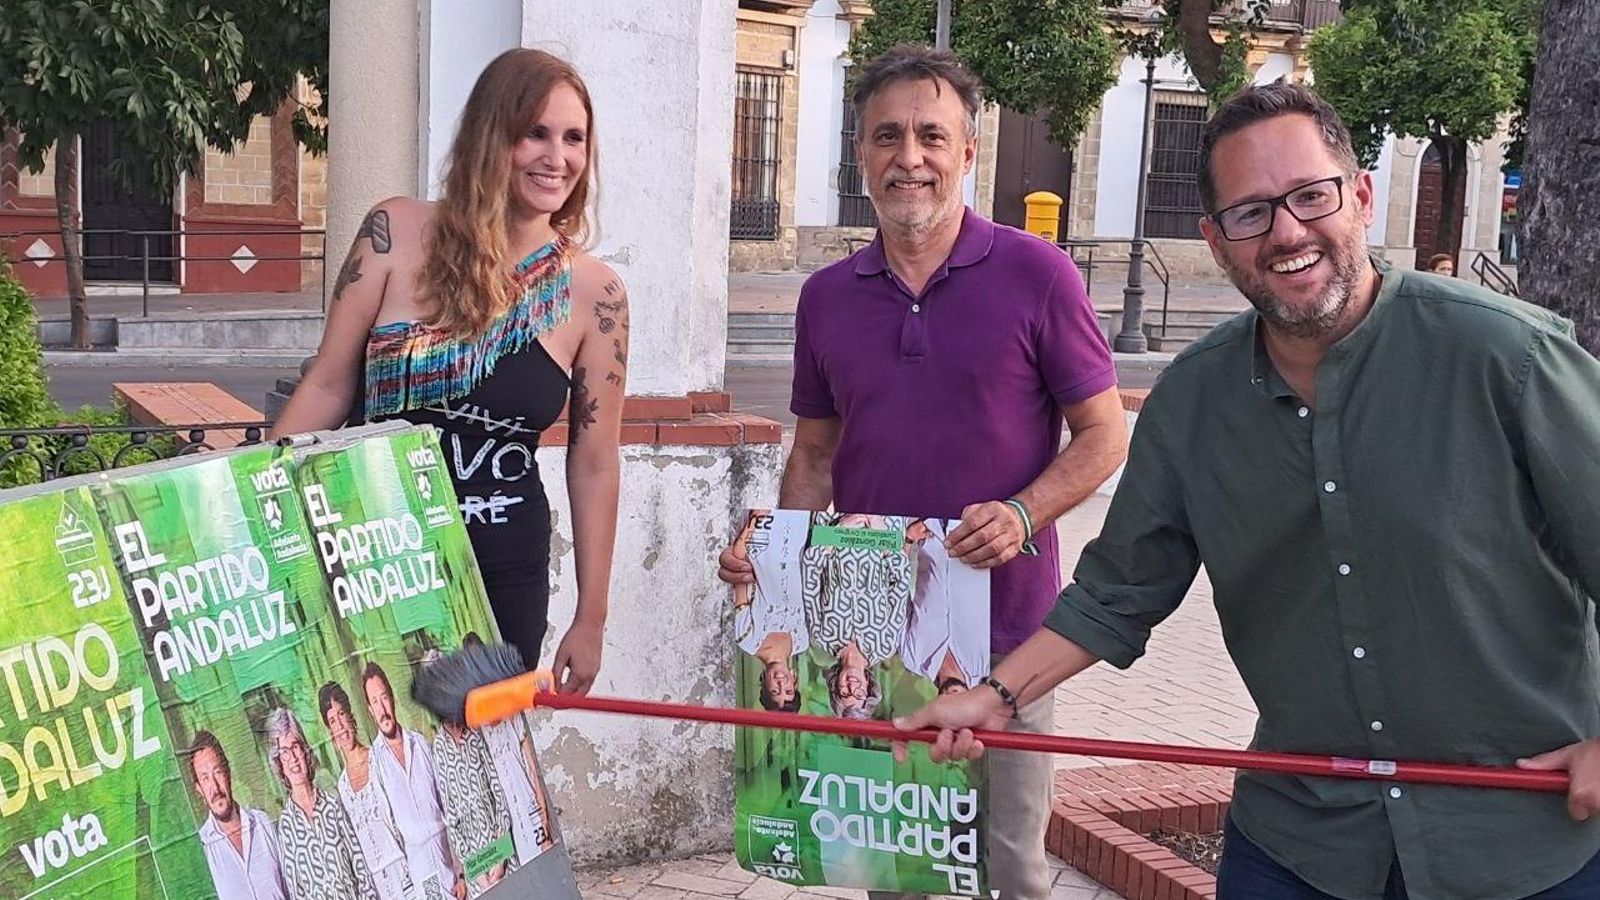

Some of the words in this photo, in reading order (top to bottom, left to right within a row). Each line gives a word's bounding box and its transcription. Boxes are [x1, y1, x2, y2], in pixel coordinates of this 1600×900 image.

[251, 466, 290, 492] vota
[406, 446, 437, 468] vota
[303, 484, 342, 527] EL
[114, 521, 166, 573] EL
[316, 512, 423, 573] PARTIDO
[67, 567, 112, 608] 23J
[133, 546, 270, 627] PARTIDO
[333, 553, 446, 618] ANDALUZ
[154, 590, 296, 682] ANDALUZ
[0, 623, 119, 728] TIDO
[799, 769, 977, 824] ANDALUZ
[19, 813, 108, 878] vota
[810, 809, 977, 863] PARTIDO
[754, 865, 805, 880] vota
[932, 863, 980, 896] EL
